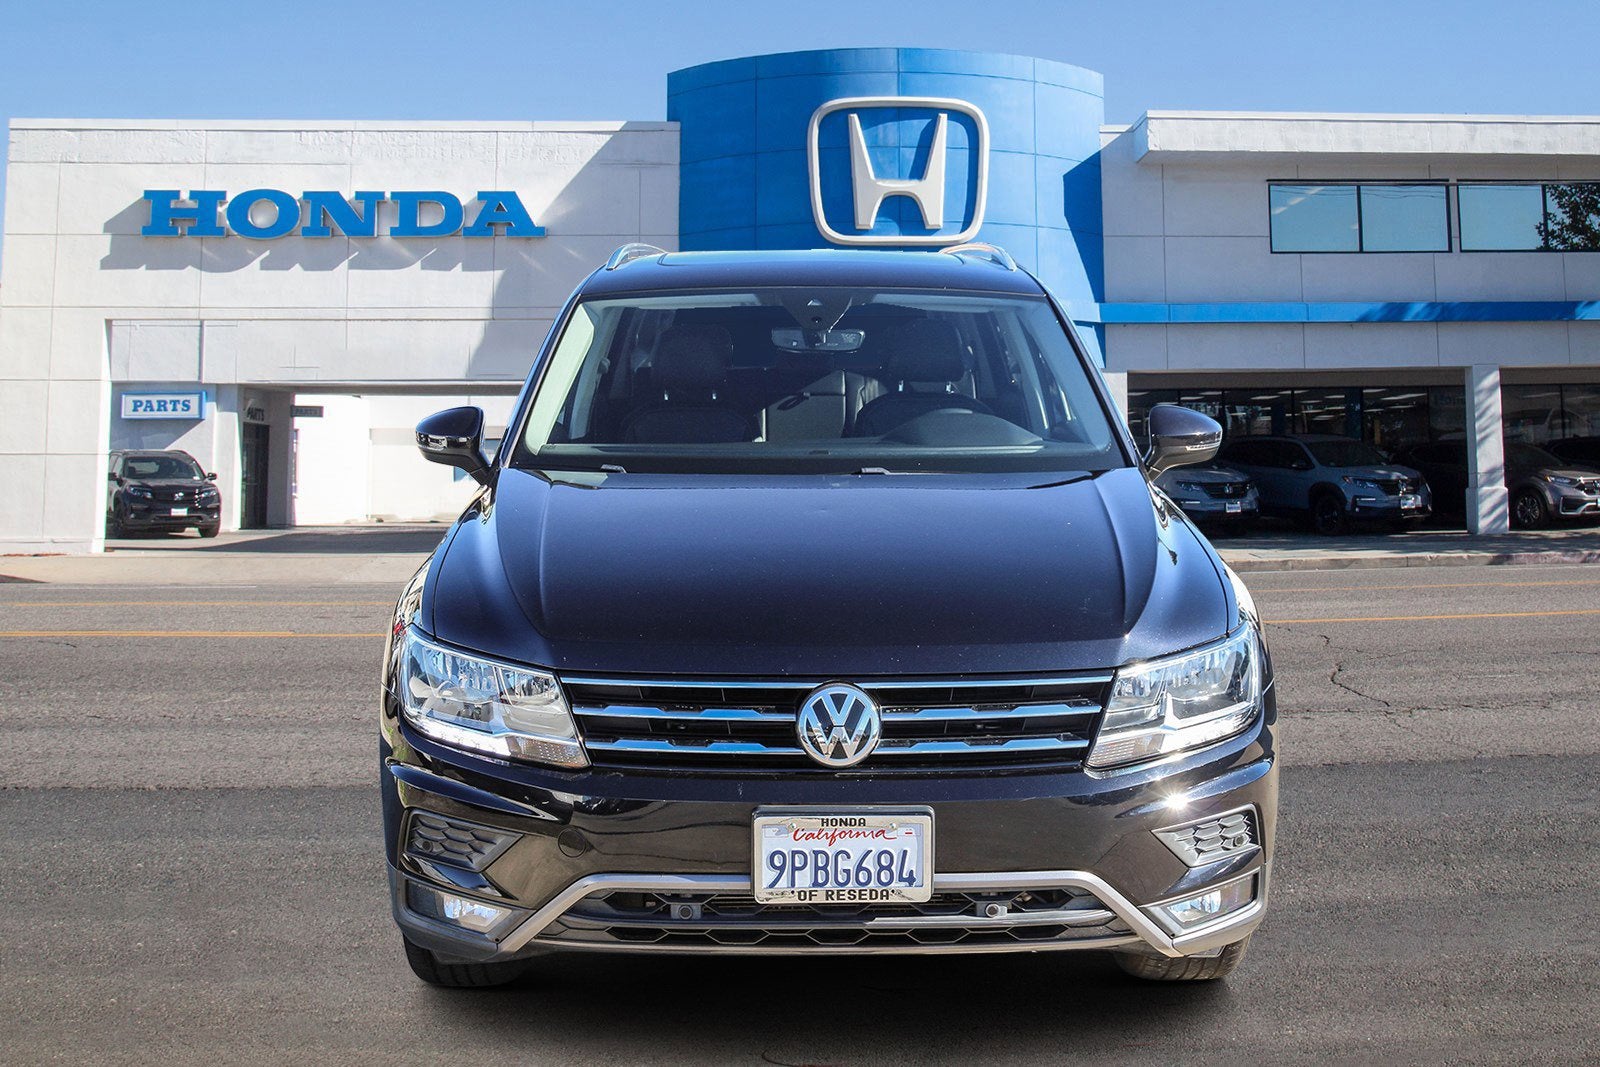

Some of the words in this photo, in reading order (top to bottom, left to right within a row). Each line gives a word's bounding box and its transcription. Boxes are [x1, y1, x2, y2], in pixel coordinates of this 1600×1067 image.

[142, 189, 547, 240] HONDA
[132, 400, 191, 412] PARTS
[821, 818, 866, 827] HONDA
[793, 828, 897, 846] California
[768, 850, 917, 888] 9PBG684
[796, 889, 818, 901] OF
[825, 889, 890, 901] RESEDA
